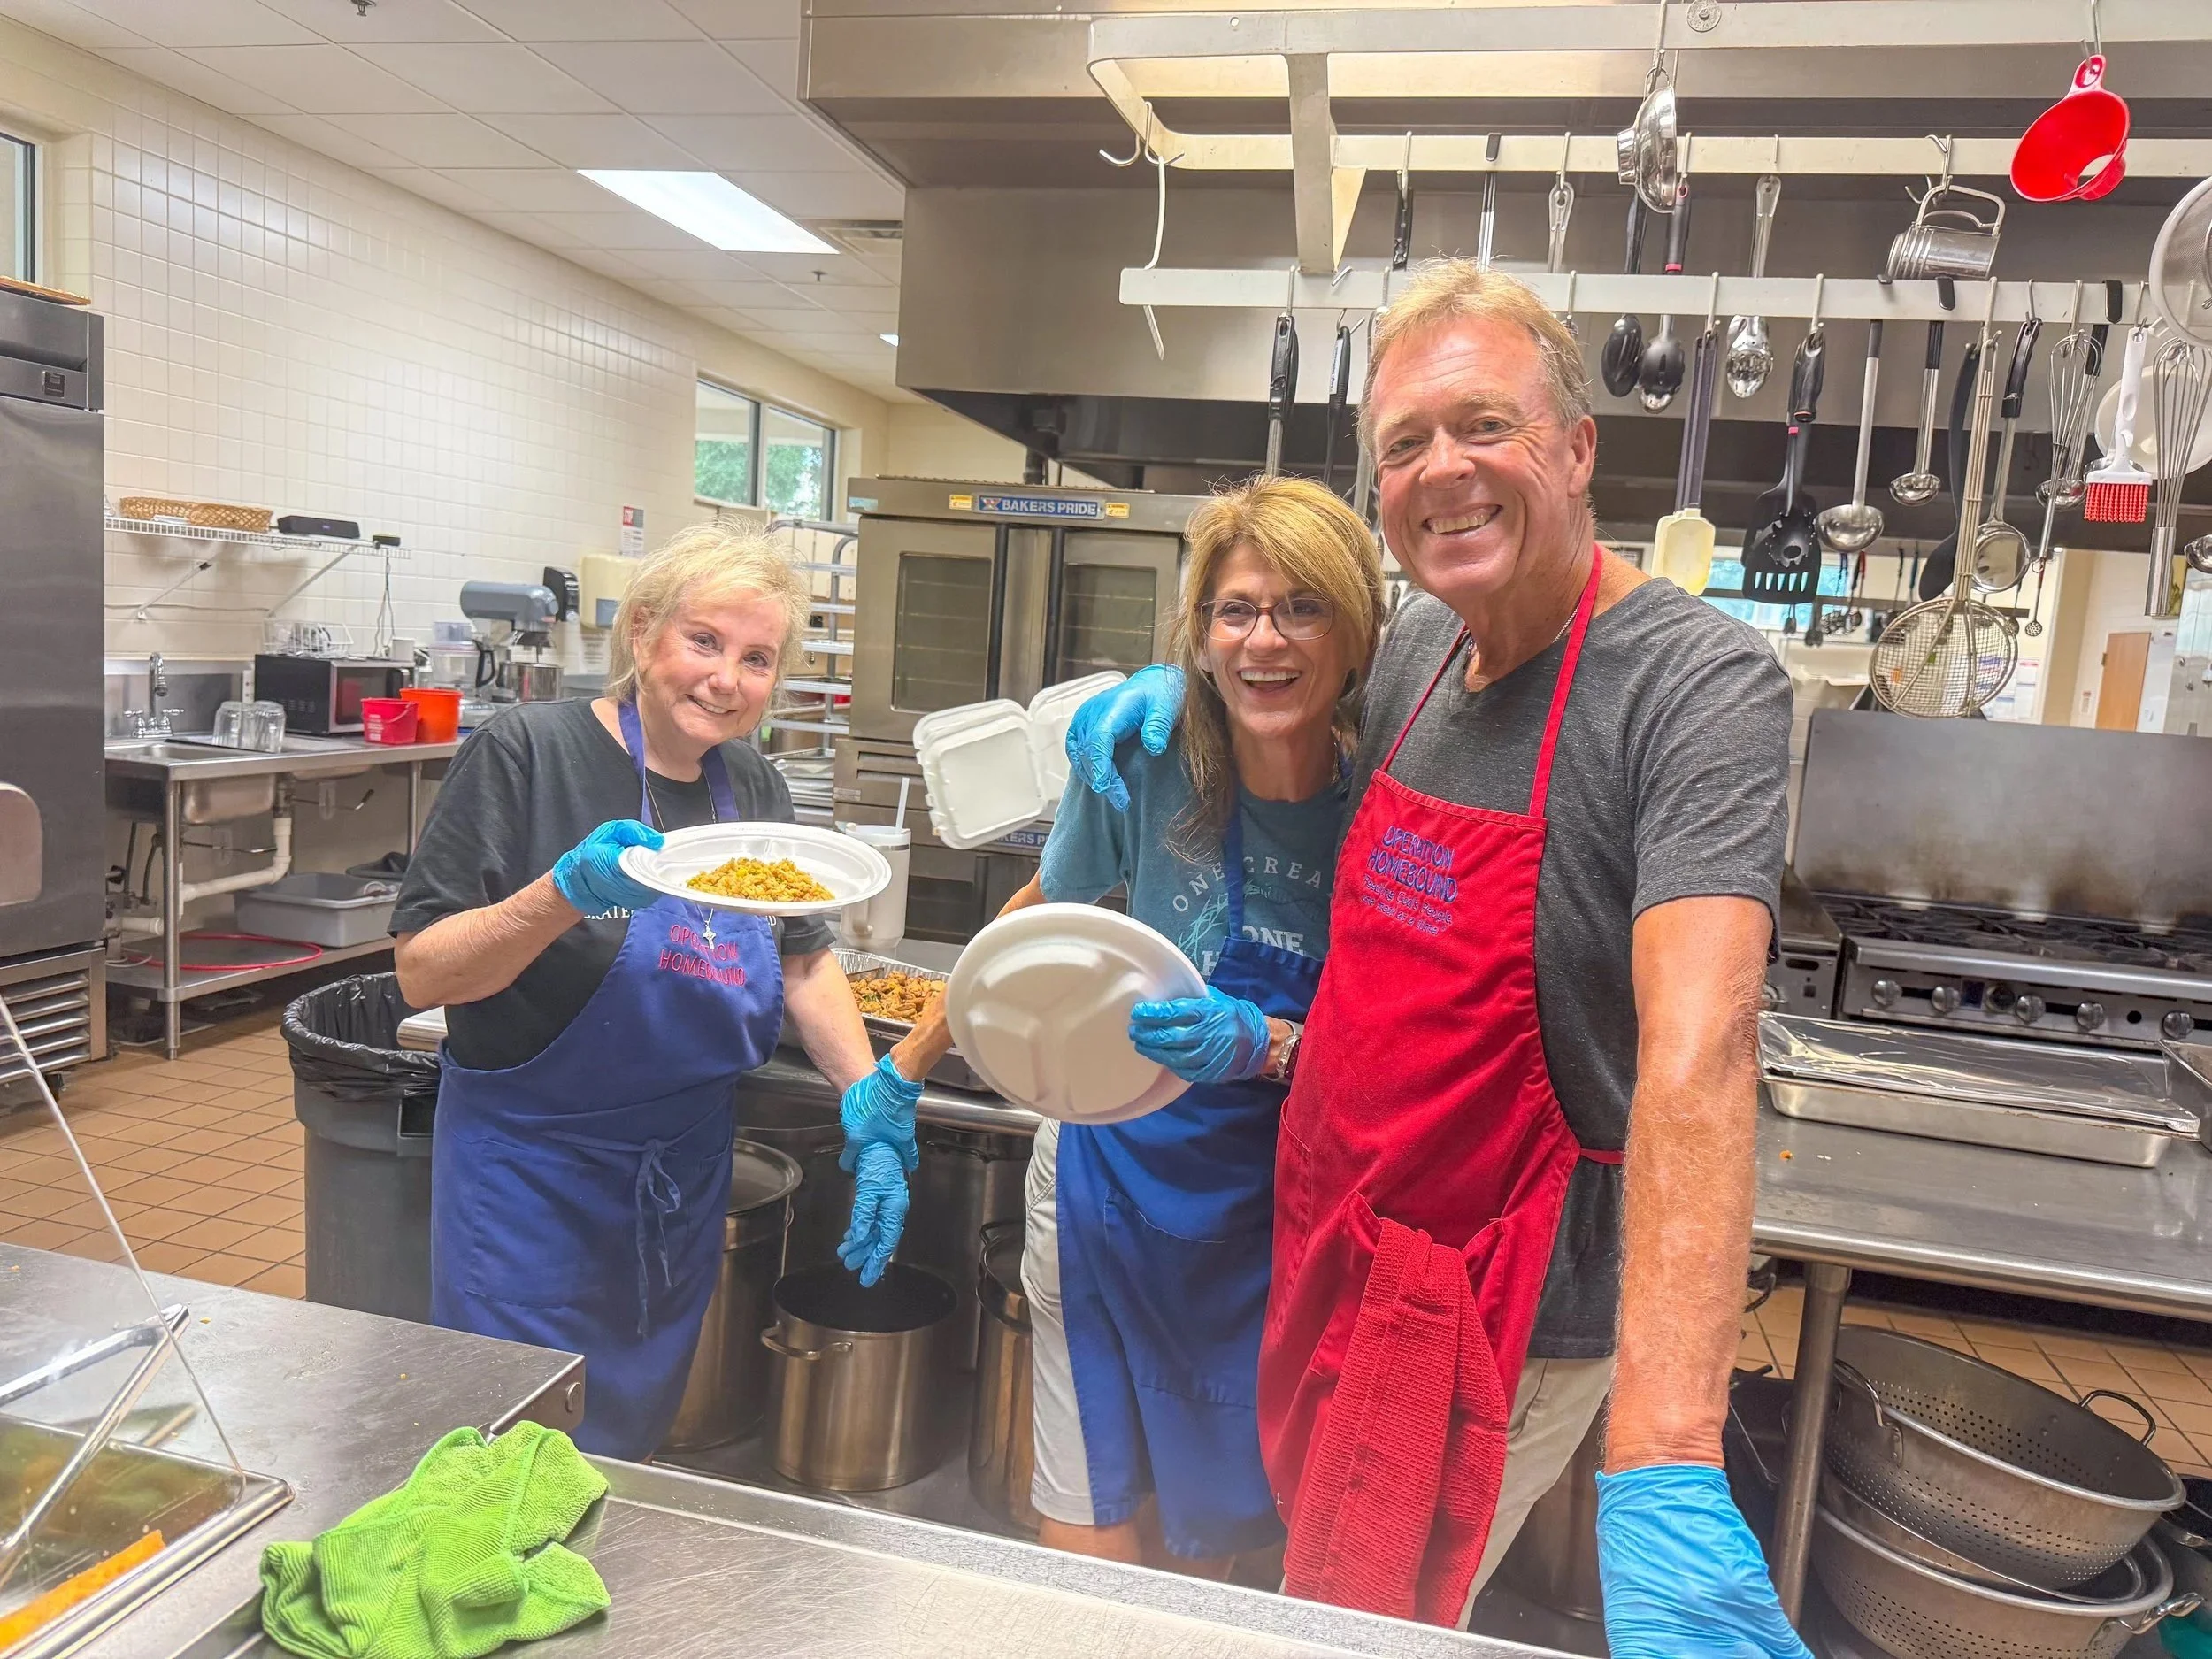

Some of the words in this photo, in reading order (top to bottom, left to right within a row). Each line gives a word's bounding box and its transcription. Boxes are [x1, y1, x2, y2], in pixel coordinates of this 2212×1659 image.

[1002, 496, 1056, 513] BAKERS
[1057, 501, 1097, 516] PRIDE
[998, 832, 1035, 844] KERS
[1382, 826, 1455, 870] OPERATION
[1173, 862, 1225, 912] ONE
[1367, 846, 1458, 903] HOMEBOUND
